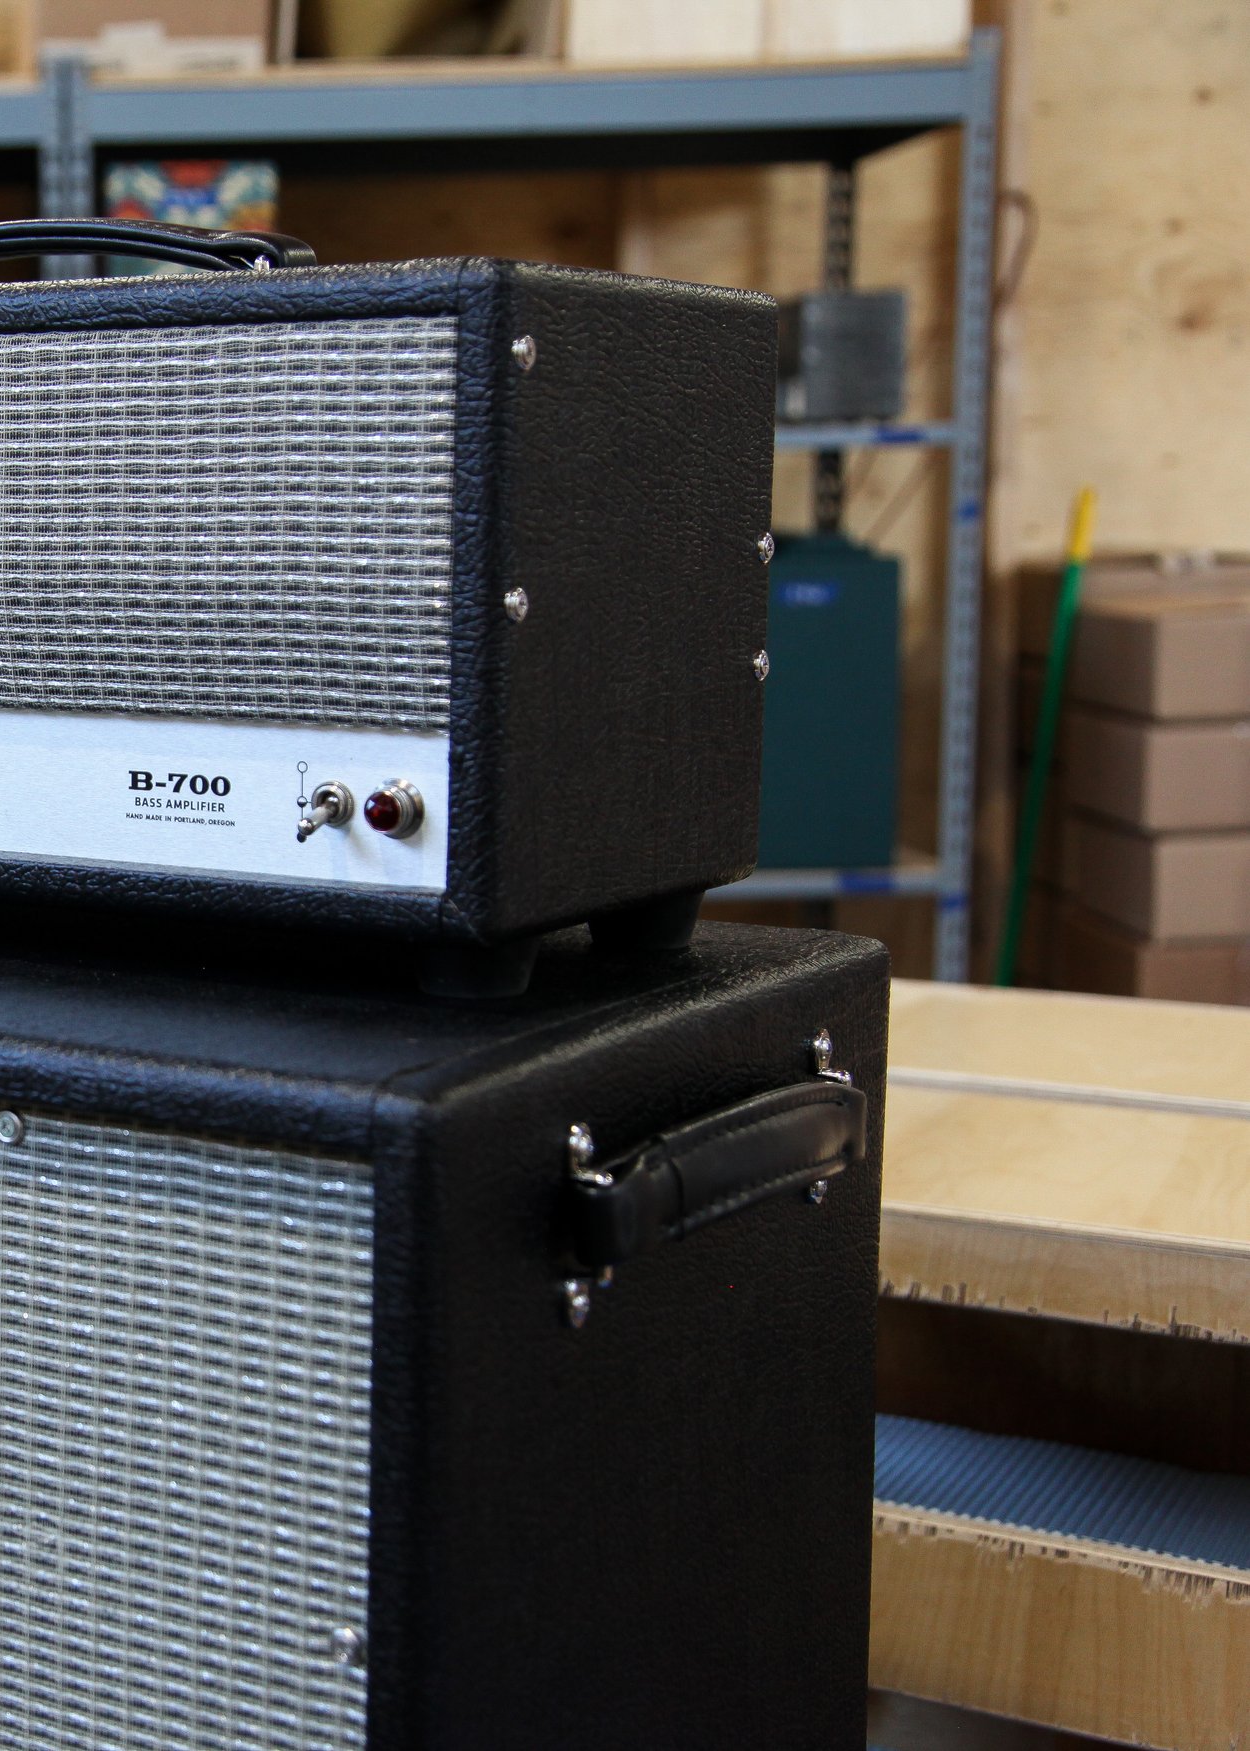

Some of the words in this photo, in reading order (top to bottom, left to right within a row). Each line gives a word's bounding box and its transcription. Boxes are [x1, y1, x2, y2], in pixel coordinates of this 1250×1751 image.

[128, 770, 231, 797] B-700
[134, 796, 163, 808] BASS
[165, 798, 226, 813] AMPLIFIER
[125, 812, 144, 820] HAND
[145, 814, 163, 822] MADE
[173, 816, 208, 826] PORTLAND,
[208, 818, 236, 827] OREGON
